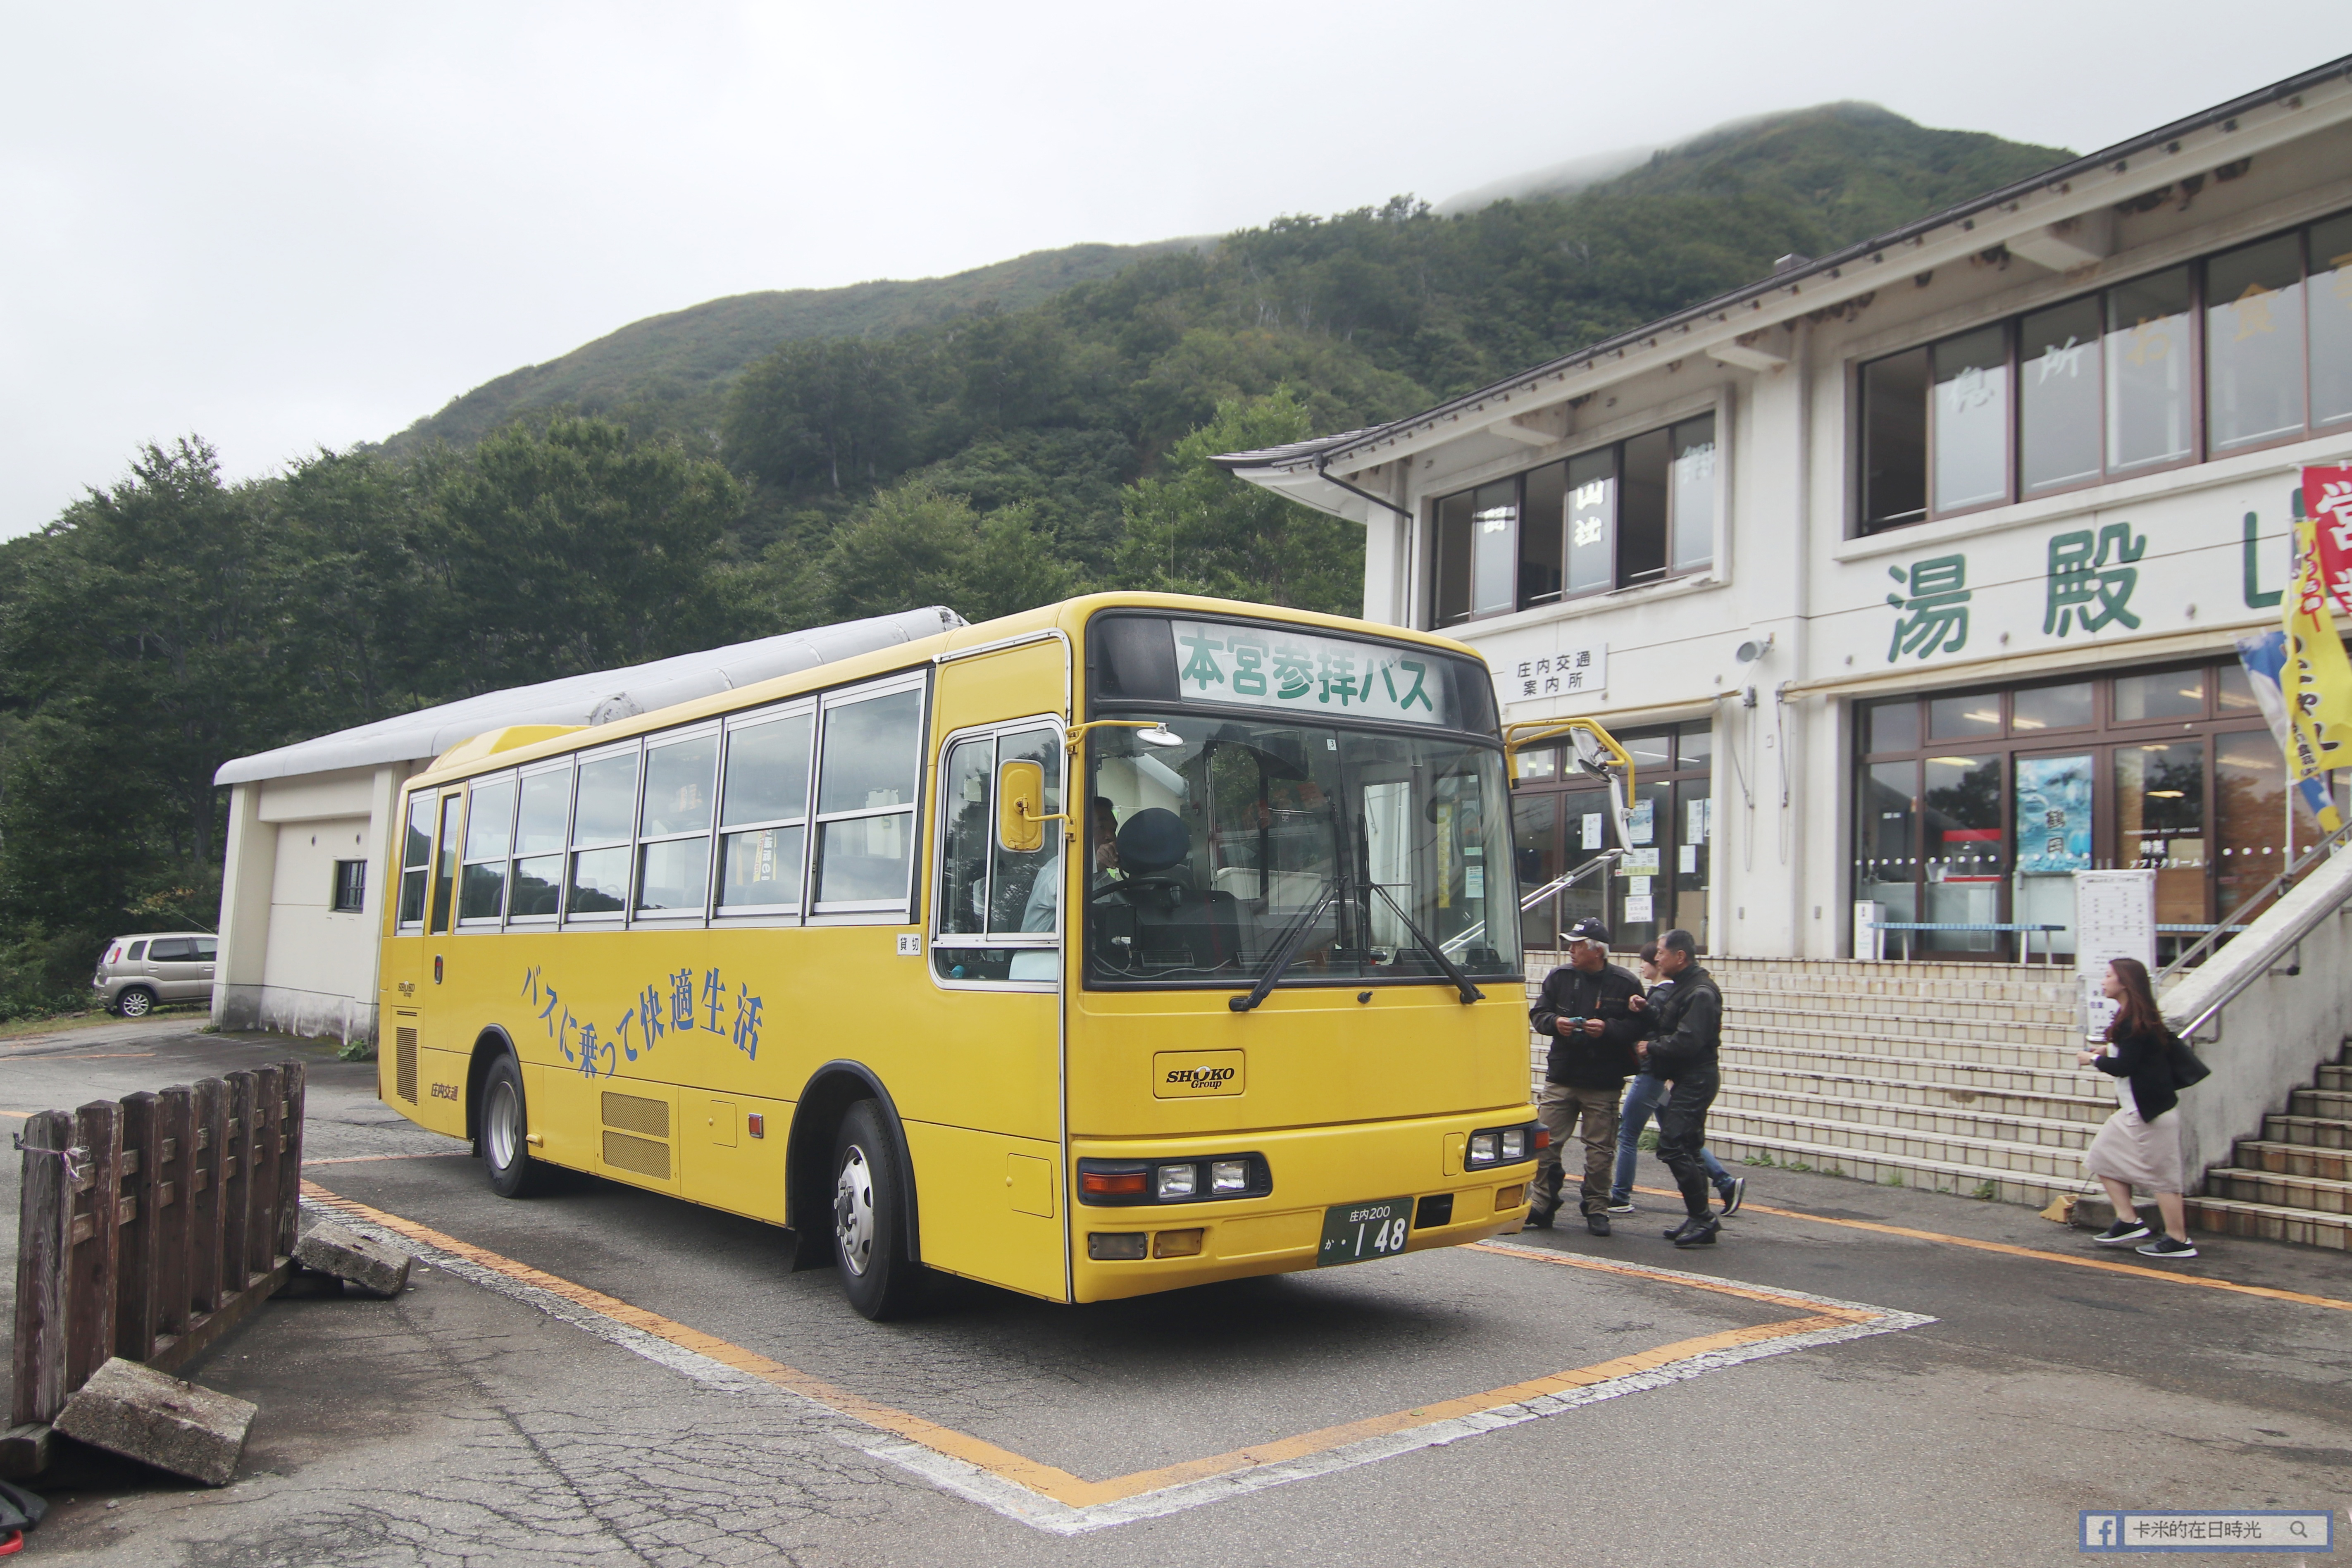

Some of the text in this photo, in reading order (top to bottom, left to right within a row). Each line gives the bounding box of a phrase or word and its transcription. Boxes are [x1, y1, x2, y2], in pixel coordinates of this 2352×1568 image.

[1179, 627, 1433, 712] 本宮参拝バス
[1517, 650, 1591, 678] 庄内交通
[1523, 672, 1583, 696] 案内所
[2129, 857, 2202, 869] ソフトクリーム
[901, 937, 919, 951] 貸切
[520, 964, 763, 1079] バスに乗って快適生活
[1166, 1065, 1235, 1083] SHOKO
[431, 1082, 458, 1102] 庄内交通
[1191, 1079, 1222, 1089] Group
[1349, 1206, 1391, 1222] 庄内200
